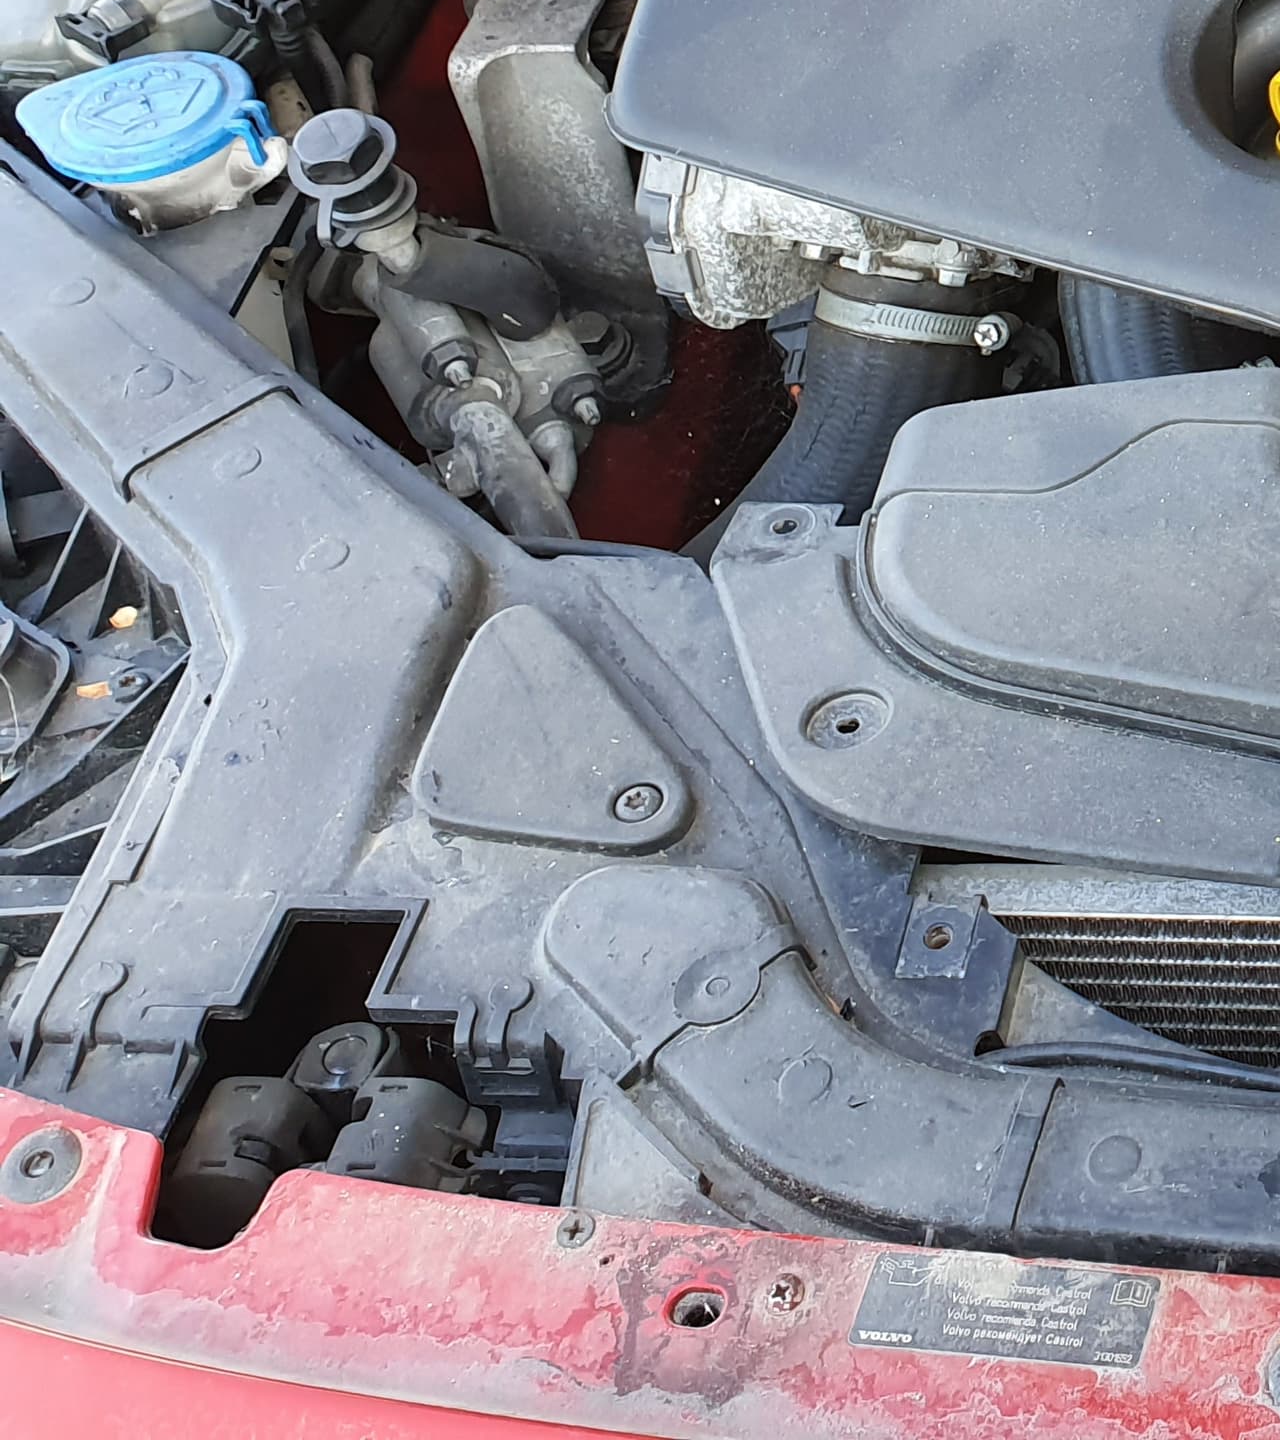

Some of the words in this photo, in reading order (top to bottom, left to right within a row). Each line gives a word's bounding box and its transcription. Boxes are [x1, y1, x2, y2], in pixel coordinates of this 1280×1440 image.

[952, 1292, 982, 1306] Volvo
[1051, 1303, 1088, 1317] Castrol
[947, 1308, 977, 1321] Volvo
[1041, 1317, 1079, 1331] Castrol
[857, 1329, 913, 1344] VOLVO
[942, 1323, 971, 1336] Volvo
[1046, 1333, 1084, 1348] Castrol
